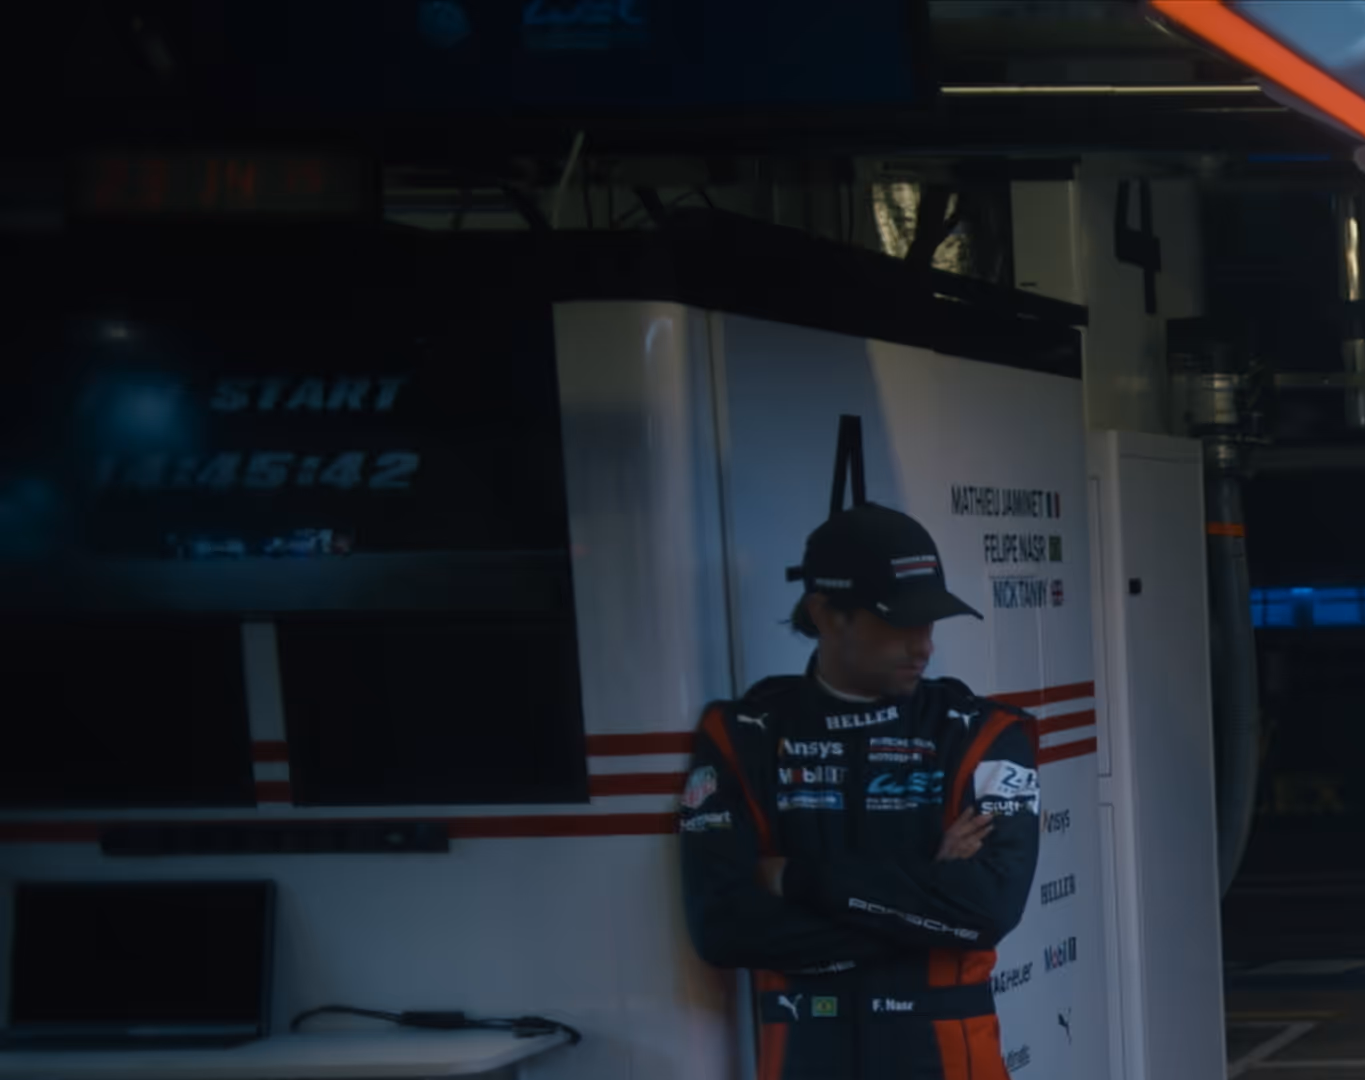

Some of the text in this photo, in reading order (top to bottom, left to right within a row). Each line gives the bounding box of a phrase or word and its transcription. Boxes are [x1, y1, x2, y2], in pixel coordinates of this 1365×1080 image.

[1115, 177, 1161, 315] 4
[209, 375, 409, 412] START
[951, 485, 1000, 516] MATHIEU
[984, 533, 1047, 563] FELIPE NASR
[993, 580, 1018, 609] NICK
[825, 705, 899, 730] HELLER
[777, 737, 844, 758] Ansys
[778, 764, 823, 785] Mobil
[1041, 808, 1070, 834] Ansys
[1041, 873, 1076, 905] HELLER
[848, 897, 980, 941] PORSCHE
[1044, 940, 1067, 972] Mobil
[871, 998, 915, 1012] F. Nasr
